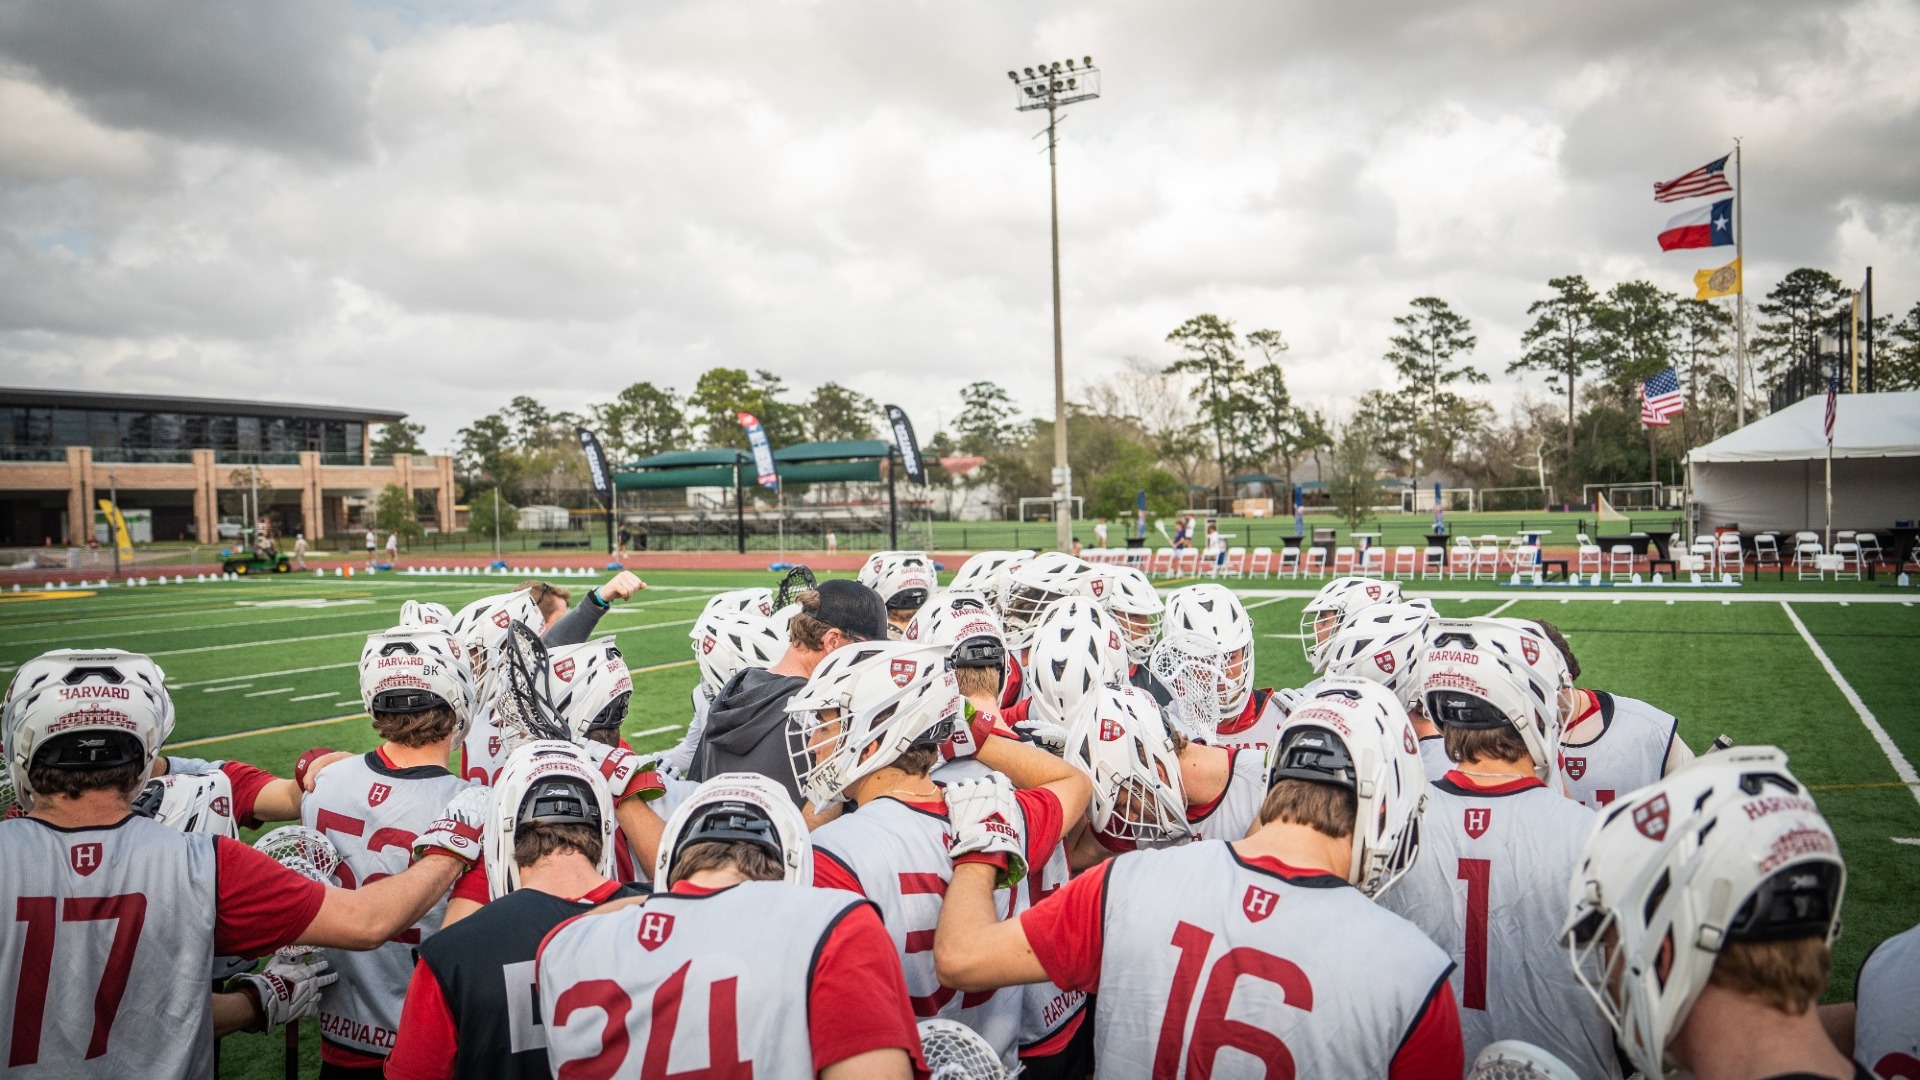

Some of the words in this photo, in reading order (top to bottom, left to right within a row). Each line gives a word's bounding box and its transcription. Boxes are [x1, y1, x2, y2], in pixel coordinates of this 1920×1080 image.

[377, 656, 424, 669] HARVARD
[1428, 650, 1480, 666] HARVARD
[59, 686, 130, 700] HARVARD
[370, 785, 386, 802] H
[1468, 811, 1485, 830] H
[76, 846, 96, 867] H
[1246, 889, 1273, 916] H
[641, 915, 668, 943] H
[1457, 857, 1491, 1011] 1
[8, 892, 148, 1068] 17
[1151, 920, 1314, 1080] 16
[320, 1011, 398, 1049] HARVARD
[553, 959, 754, 1080] 24
